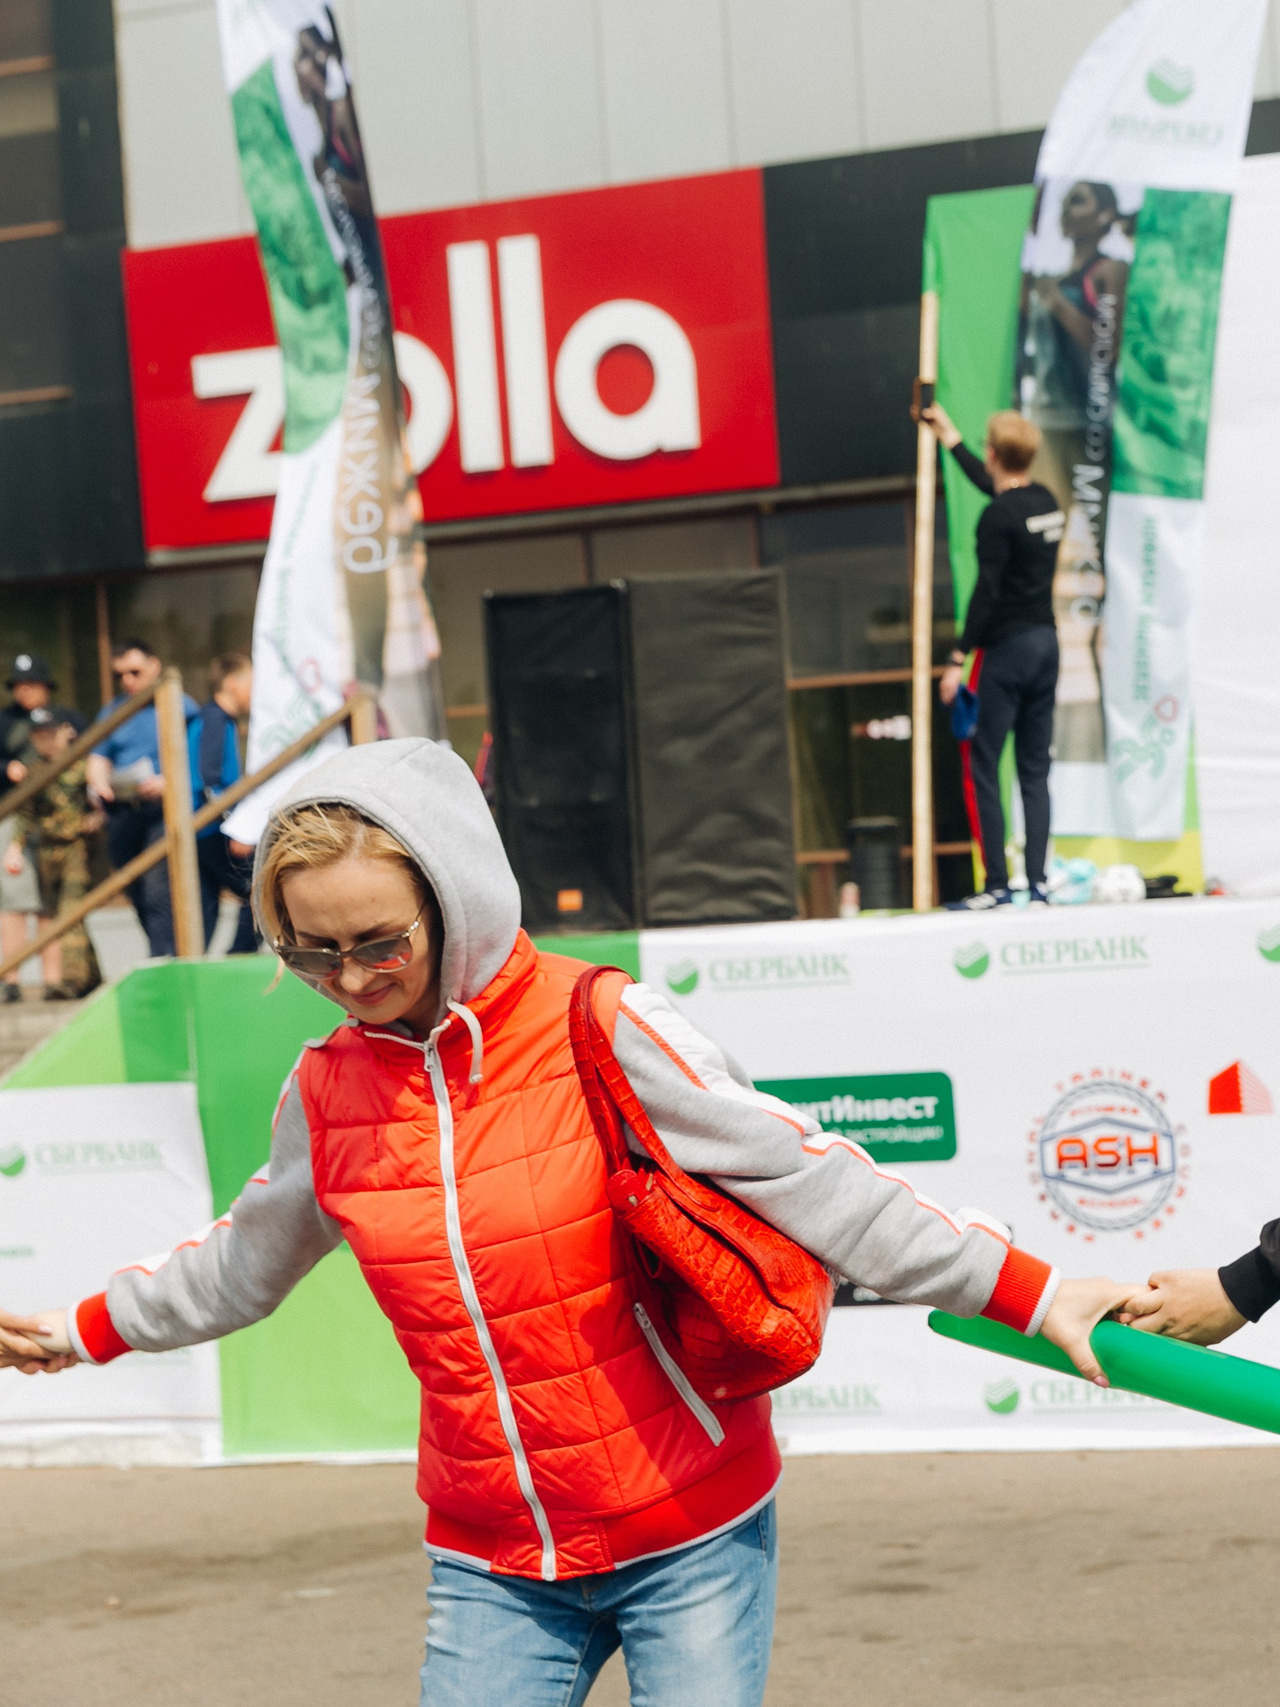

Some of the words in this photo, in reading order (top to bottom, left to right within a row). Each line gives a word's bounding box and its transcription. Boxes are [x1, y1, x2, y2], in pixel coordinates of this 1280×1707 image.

[1000, 934, 1150, 968] СБЕРБАНК
[707, 954, 850, 984] СБЕРБАНК
[1055, 1134, 1159, 1169] ASH
